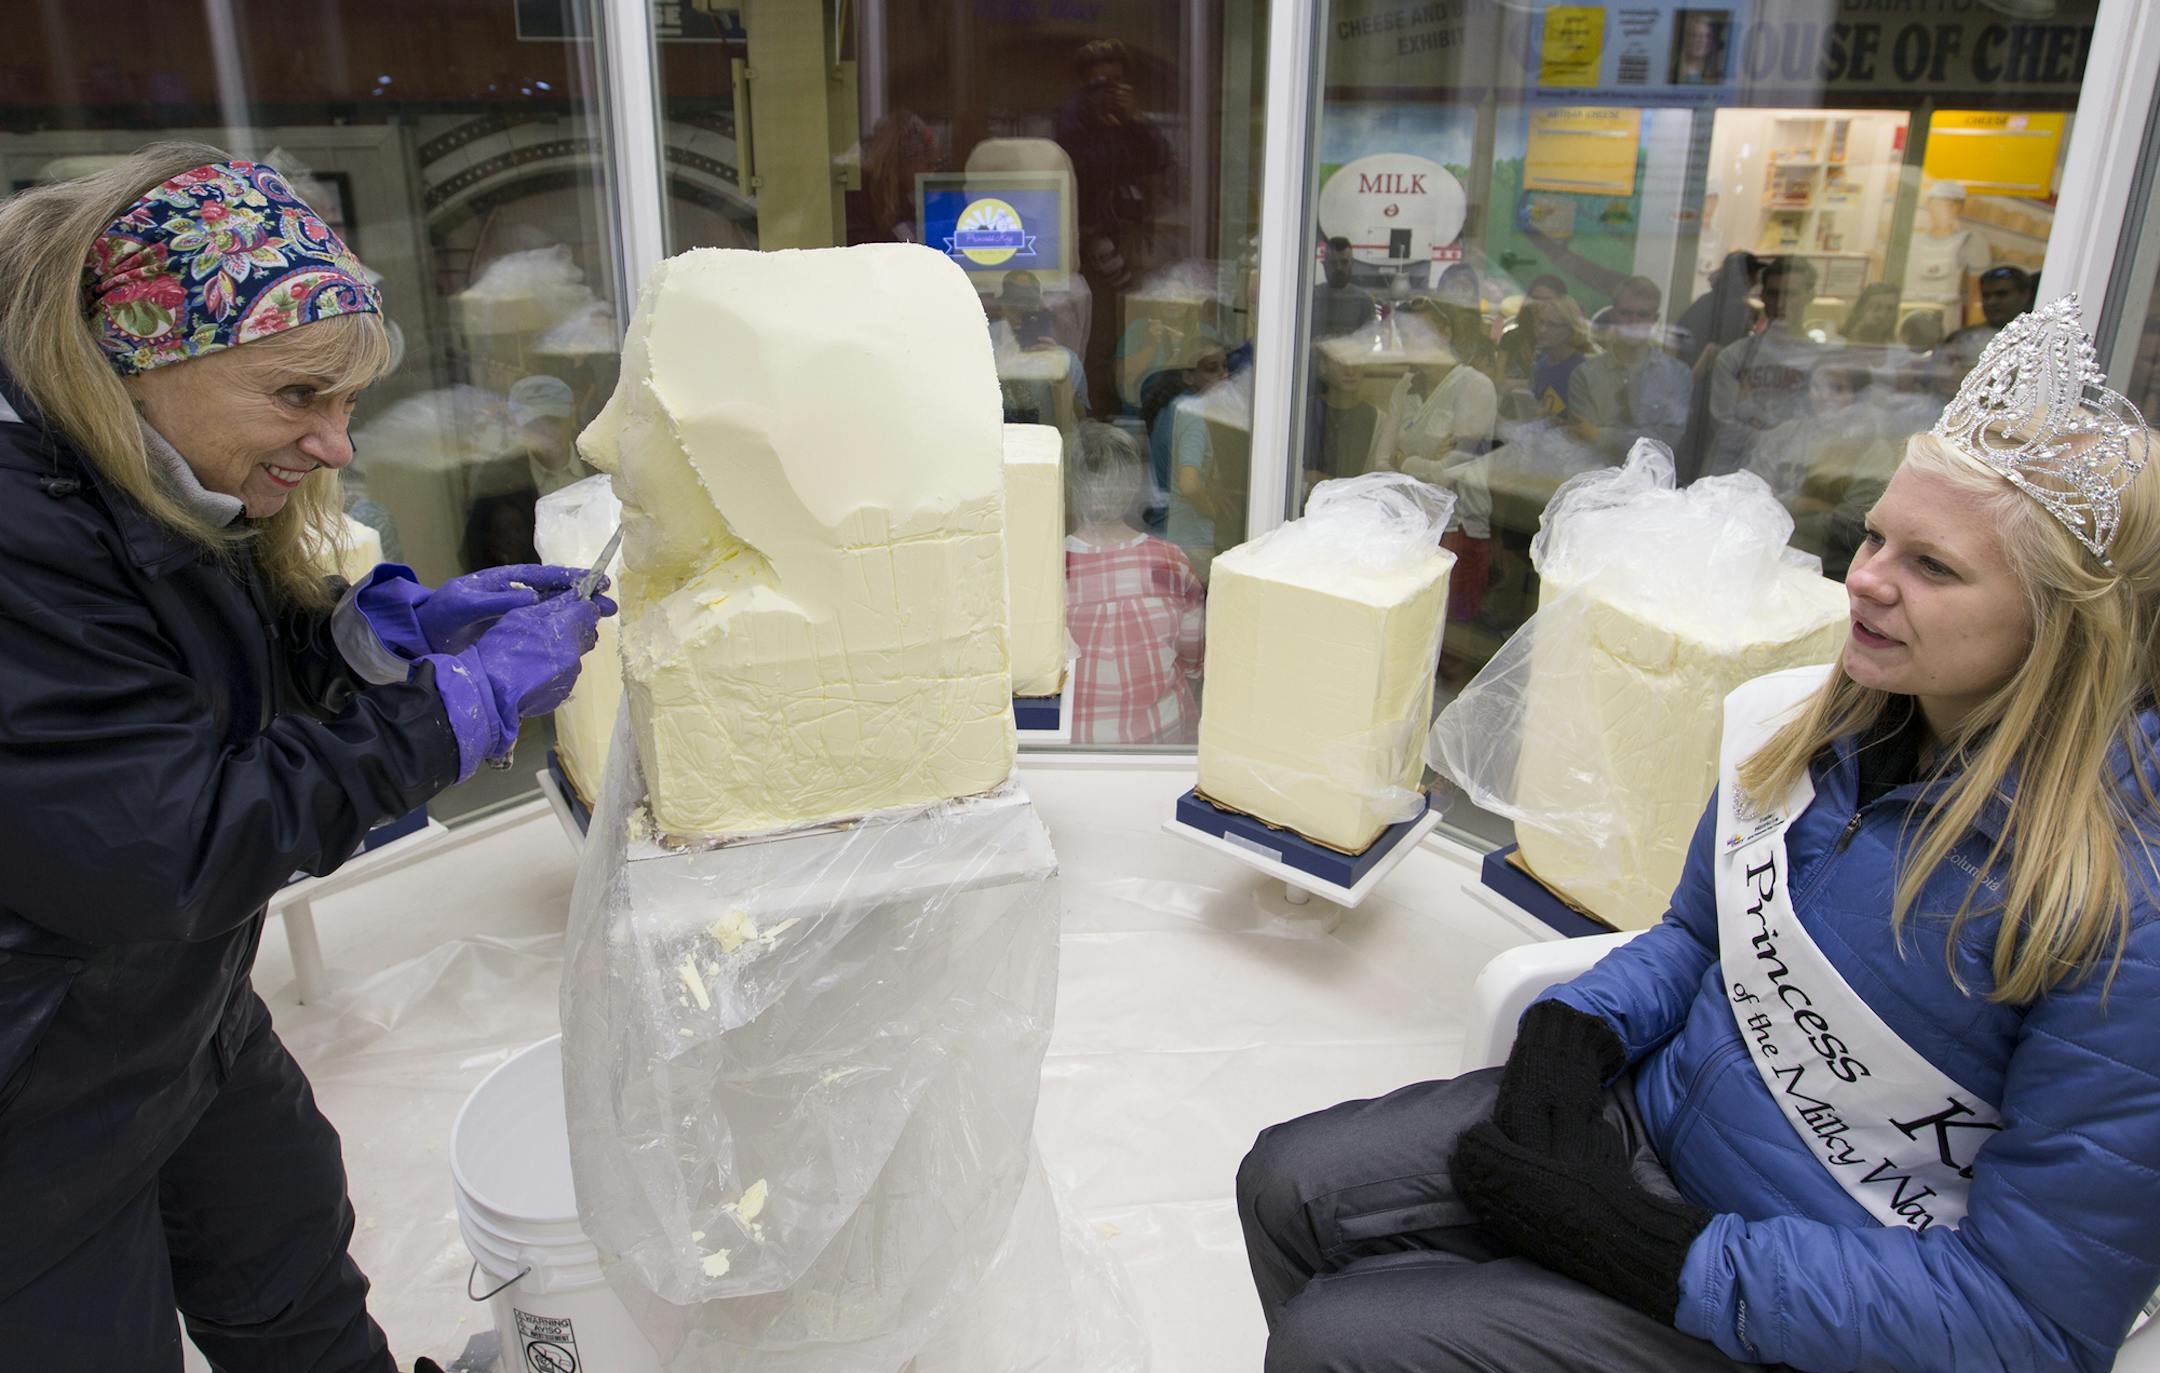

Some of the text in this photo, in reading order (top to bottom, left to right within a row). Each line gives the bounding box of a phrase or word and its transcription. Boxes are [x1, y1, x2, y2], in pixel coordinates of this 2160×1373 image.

[1338, 12, 1405, 41] CHEESE
[1411, 2, 1447, 26] AND
[1397, 27, 1466, 56] EXHIBIT
[1743, 22, 1882, 82] OUSE
[1892, 22, 1962, 82] OF
[1358, 172, 1428, 195] MILK
[1746, 850, 2003, 1178] Princess K
[1733, 982, 1760, 1008] of
[1748, 1012, 1779, 1057] the
[1772, 1063, 1865, 1167] Milky
[534, 1324, 562, 1335] AVISO
